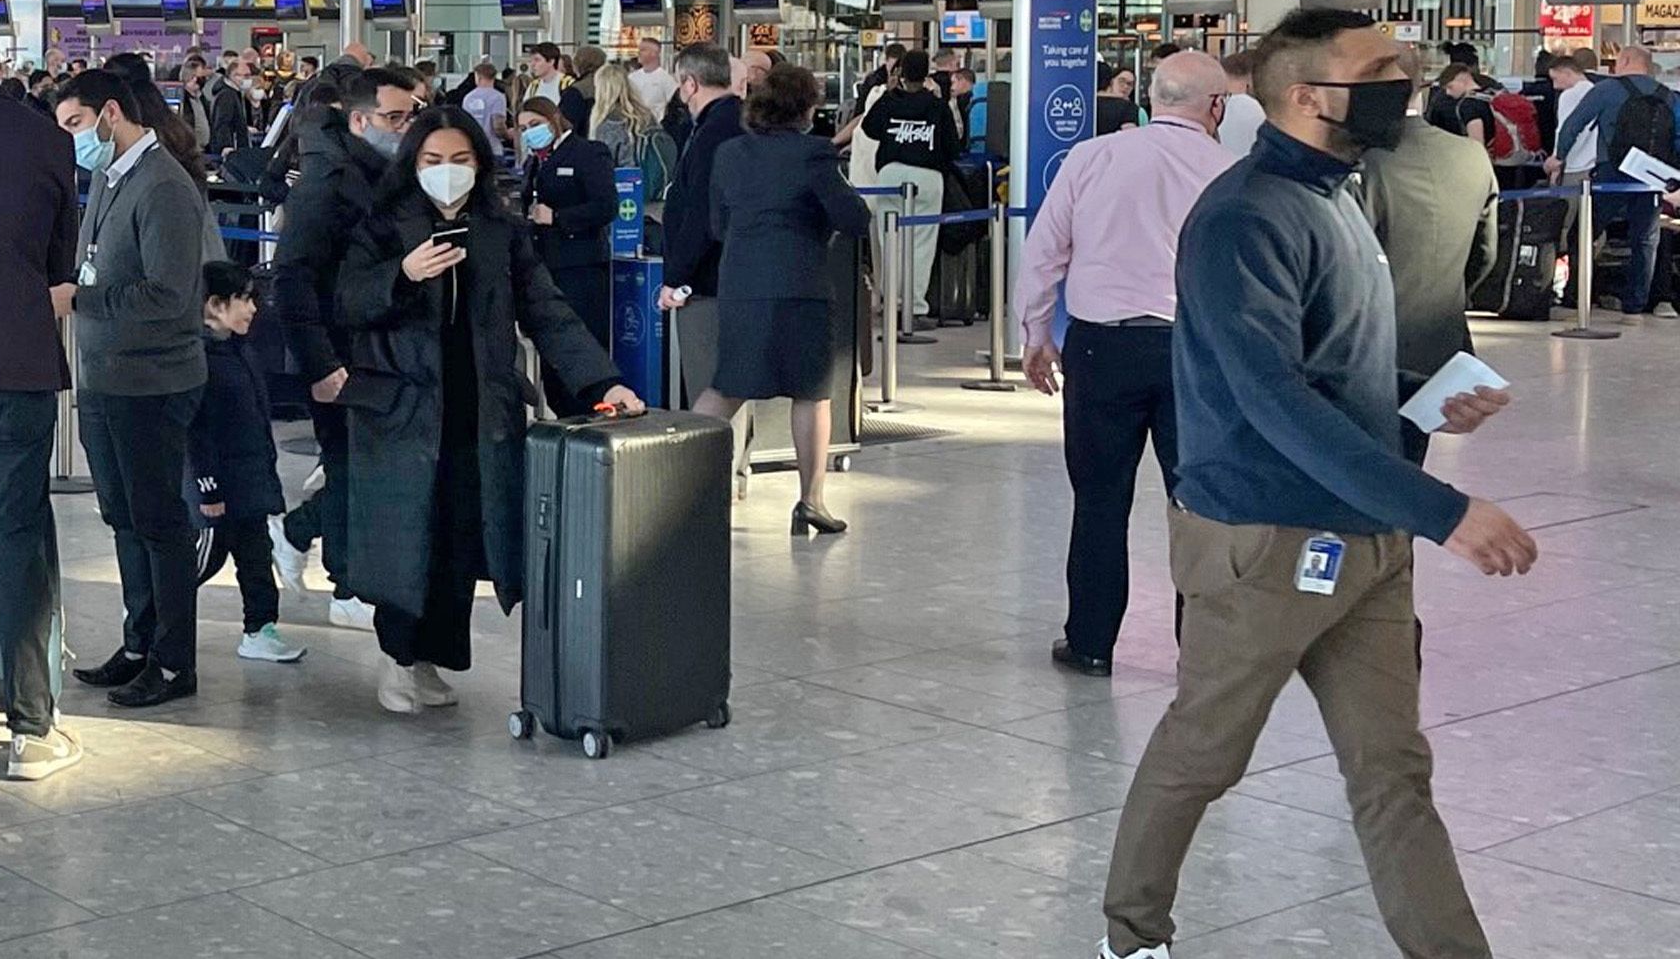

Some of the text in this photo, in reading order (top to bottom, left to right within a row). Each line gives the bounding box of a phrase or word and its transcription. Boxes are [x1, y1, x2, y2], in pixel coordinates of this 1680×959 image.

[1042, 44, 1068, 57] Taking
[1068, 46, 1082, 55] care
[1044, 58, 1087, 69] you together
